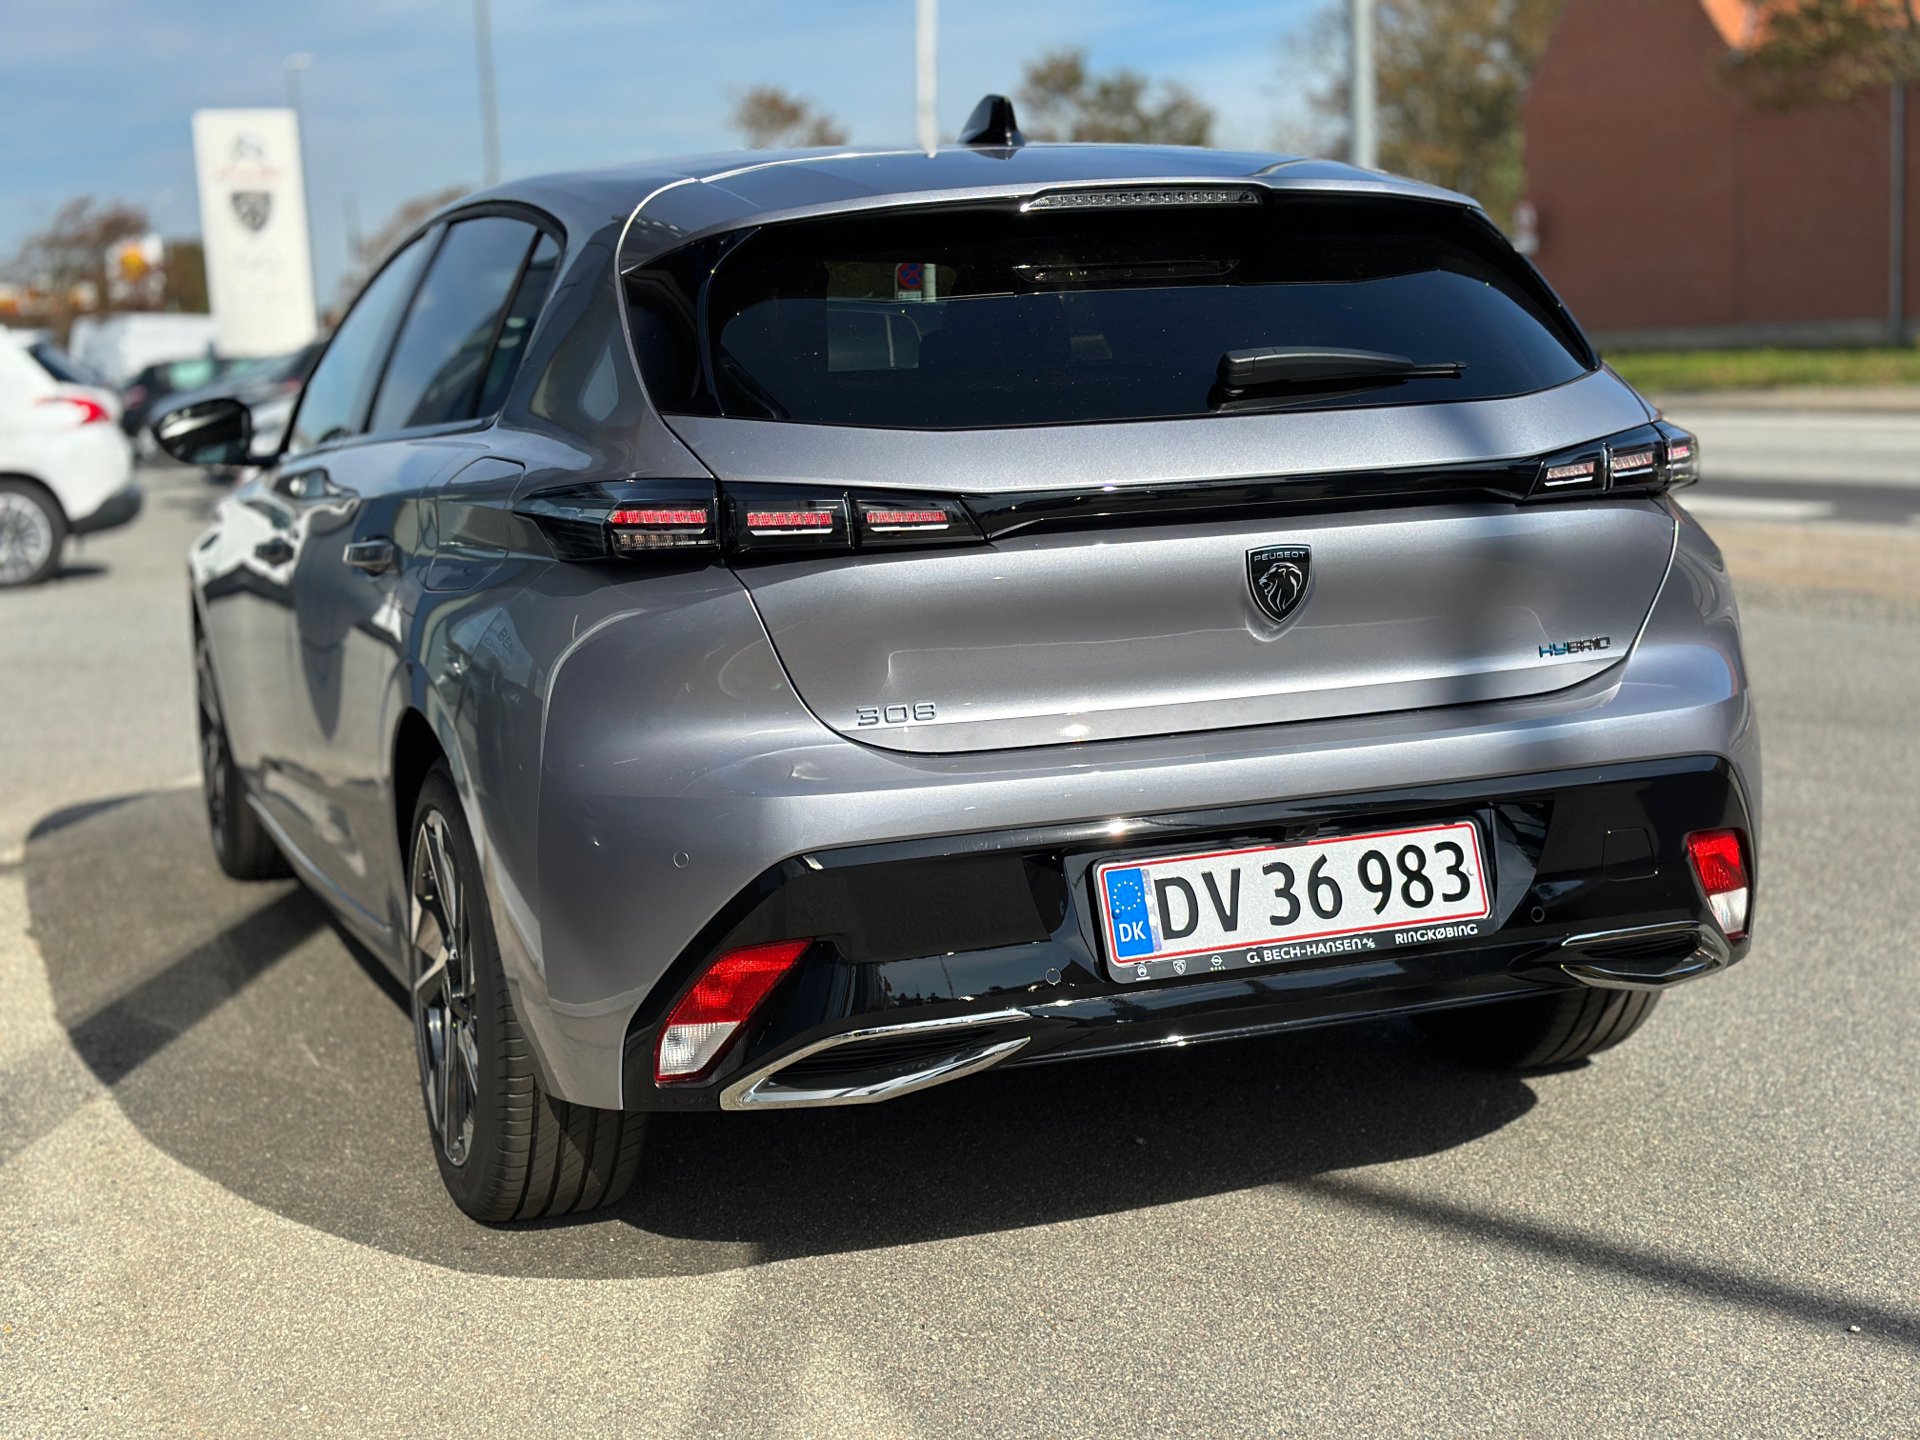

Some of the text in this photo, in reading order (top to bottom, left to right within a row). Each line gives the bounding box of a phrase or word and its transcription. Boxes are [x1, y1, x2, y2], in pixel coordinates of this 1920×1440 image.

[1253, 551, 1306, 562] PEUGEOT
[1538, 636, 1611, 658] HYBRID
[856, 702, 937, 727] 308
[1153, 841, 1472, 941] DV 36 983
[1117, 920, 1148, 943] DK
[1246, 951, 1261, 964] G.
[1263, 938, 1362, 962] BECH-HANSEN
[1394, 923, 1479, 945] RINGKØBING
